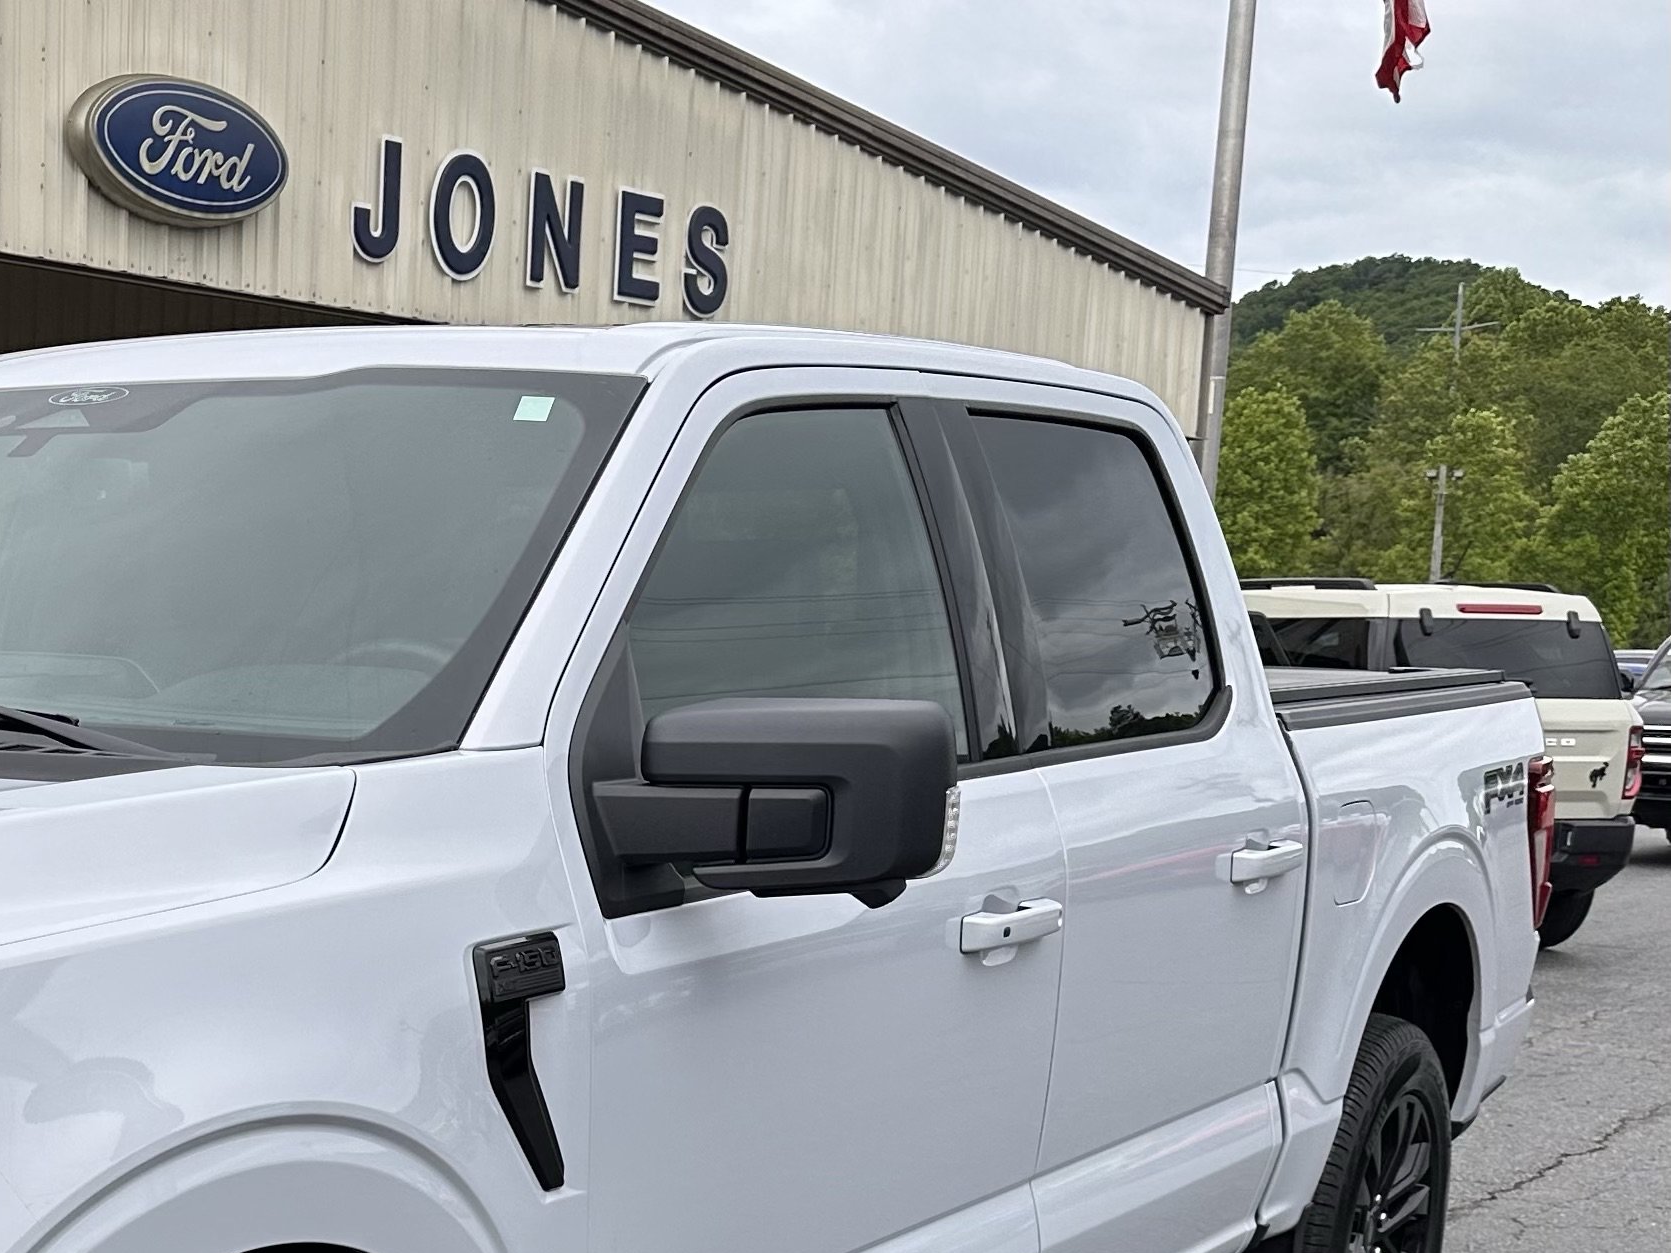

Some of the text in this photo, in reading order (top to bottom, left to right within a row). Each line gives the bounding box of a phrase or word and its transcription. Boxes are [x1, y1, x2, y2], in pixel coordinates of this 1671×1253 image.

[139, 104, 255, 193] Ford
[351, 134, 730, 320] JONES
[59, 389, 117, 403] Ford
[1484, 761, 1524, 815] FX4
